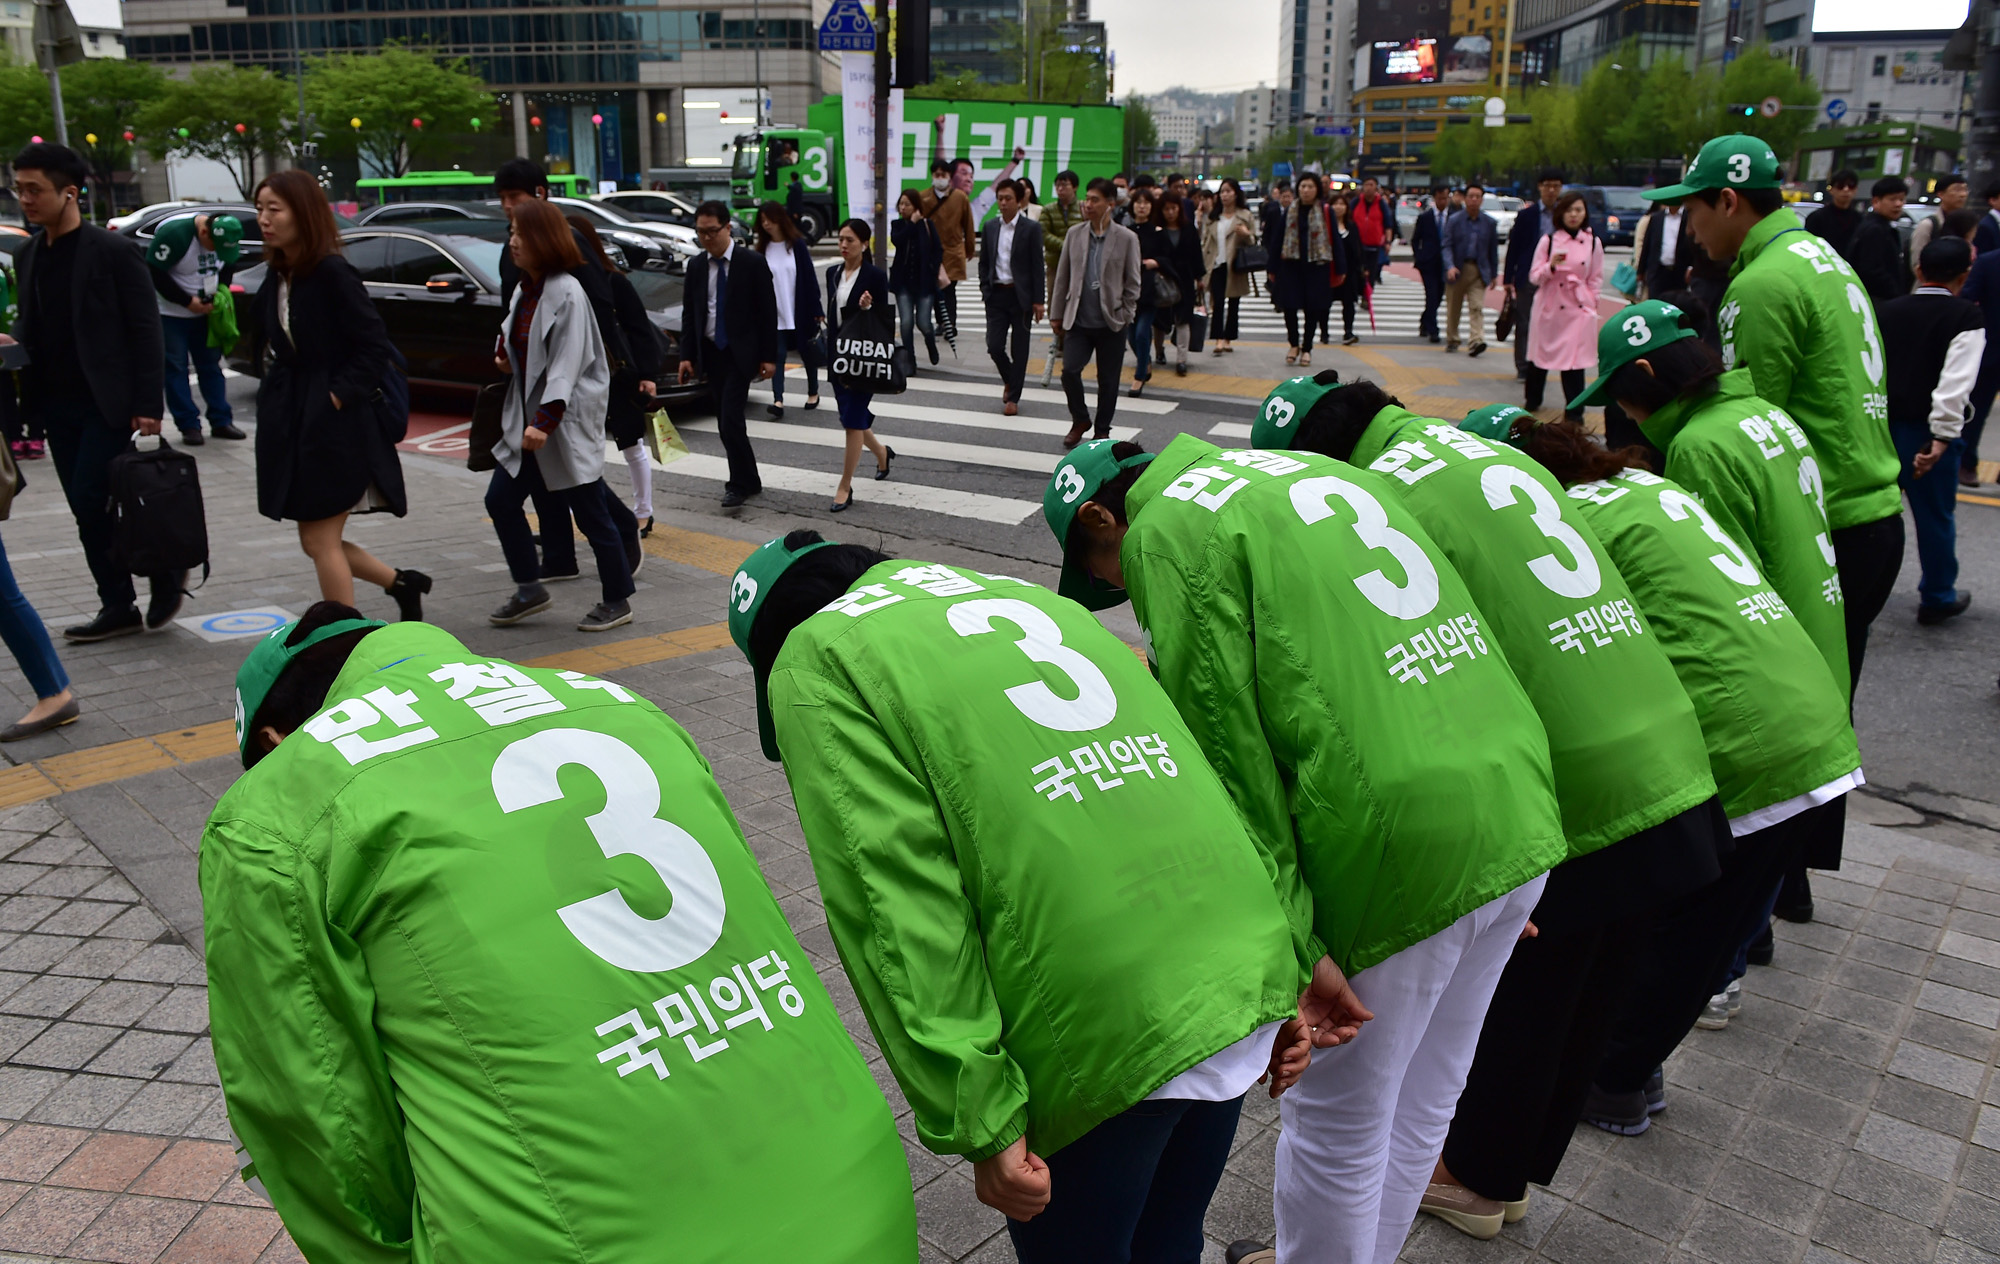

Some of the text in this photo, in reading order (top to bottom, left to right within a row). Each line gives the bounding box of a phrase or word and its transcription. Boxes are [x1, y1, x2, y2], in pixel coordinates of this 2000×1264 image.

[802, 146, 828, 189] 3
[1727, 153, 1751, 183] 3
[155, 244, 171, 261] 3
[1622, 315, 1652, 347] 3
[1846, 282, 1883, 387] 3
[833, 357, 892, 380] OUTFI
[1265, 396, 1295, 428] 3
[1055, 464, 1085, 503] 3
[1162, 449, 1321, 513] 안철
[1798, 456, 1837, 567] 3
[1289, 476, 1439, 620] 3
[1480, 464, 1601, 599] 3
[1658, 489, 1761, 586] 3
[731, 570, 758, 613] 3
[1384, 612, 1488, 685] 국민의당
[1548, 598, 1643, 654] 국민의당
[946, 598, 1118, 731] 3
[1031, 733, 1178, 802] 국민의당
[491, 728, 726, 973] 3
[594, 950, 805, 1081] 국민의당
